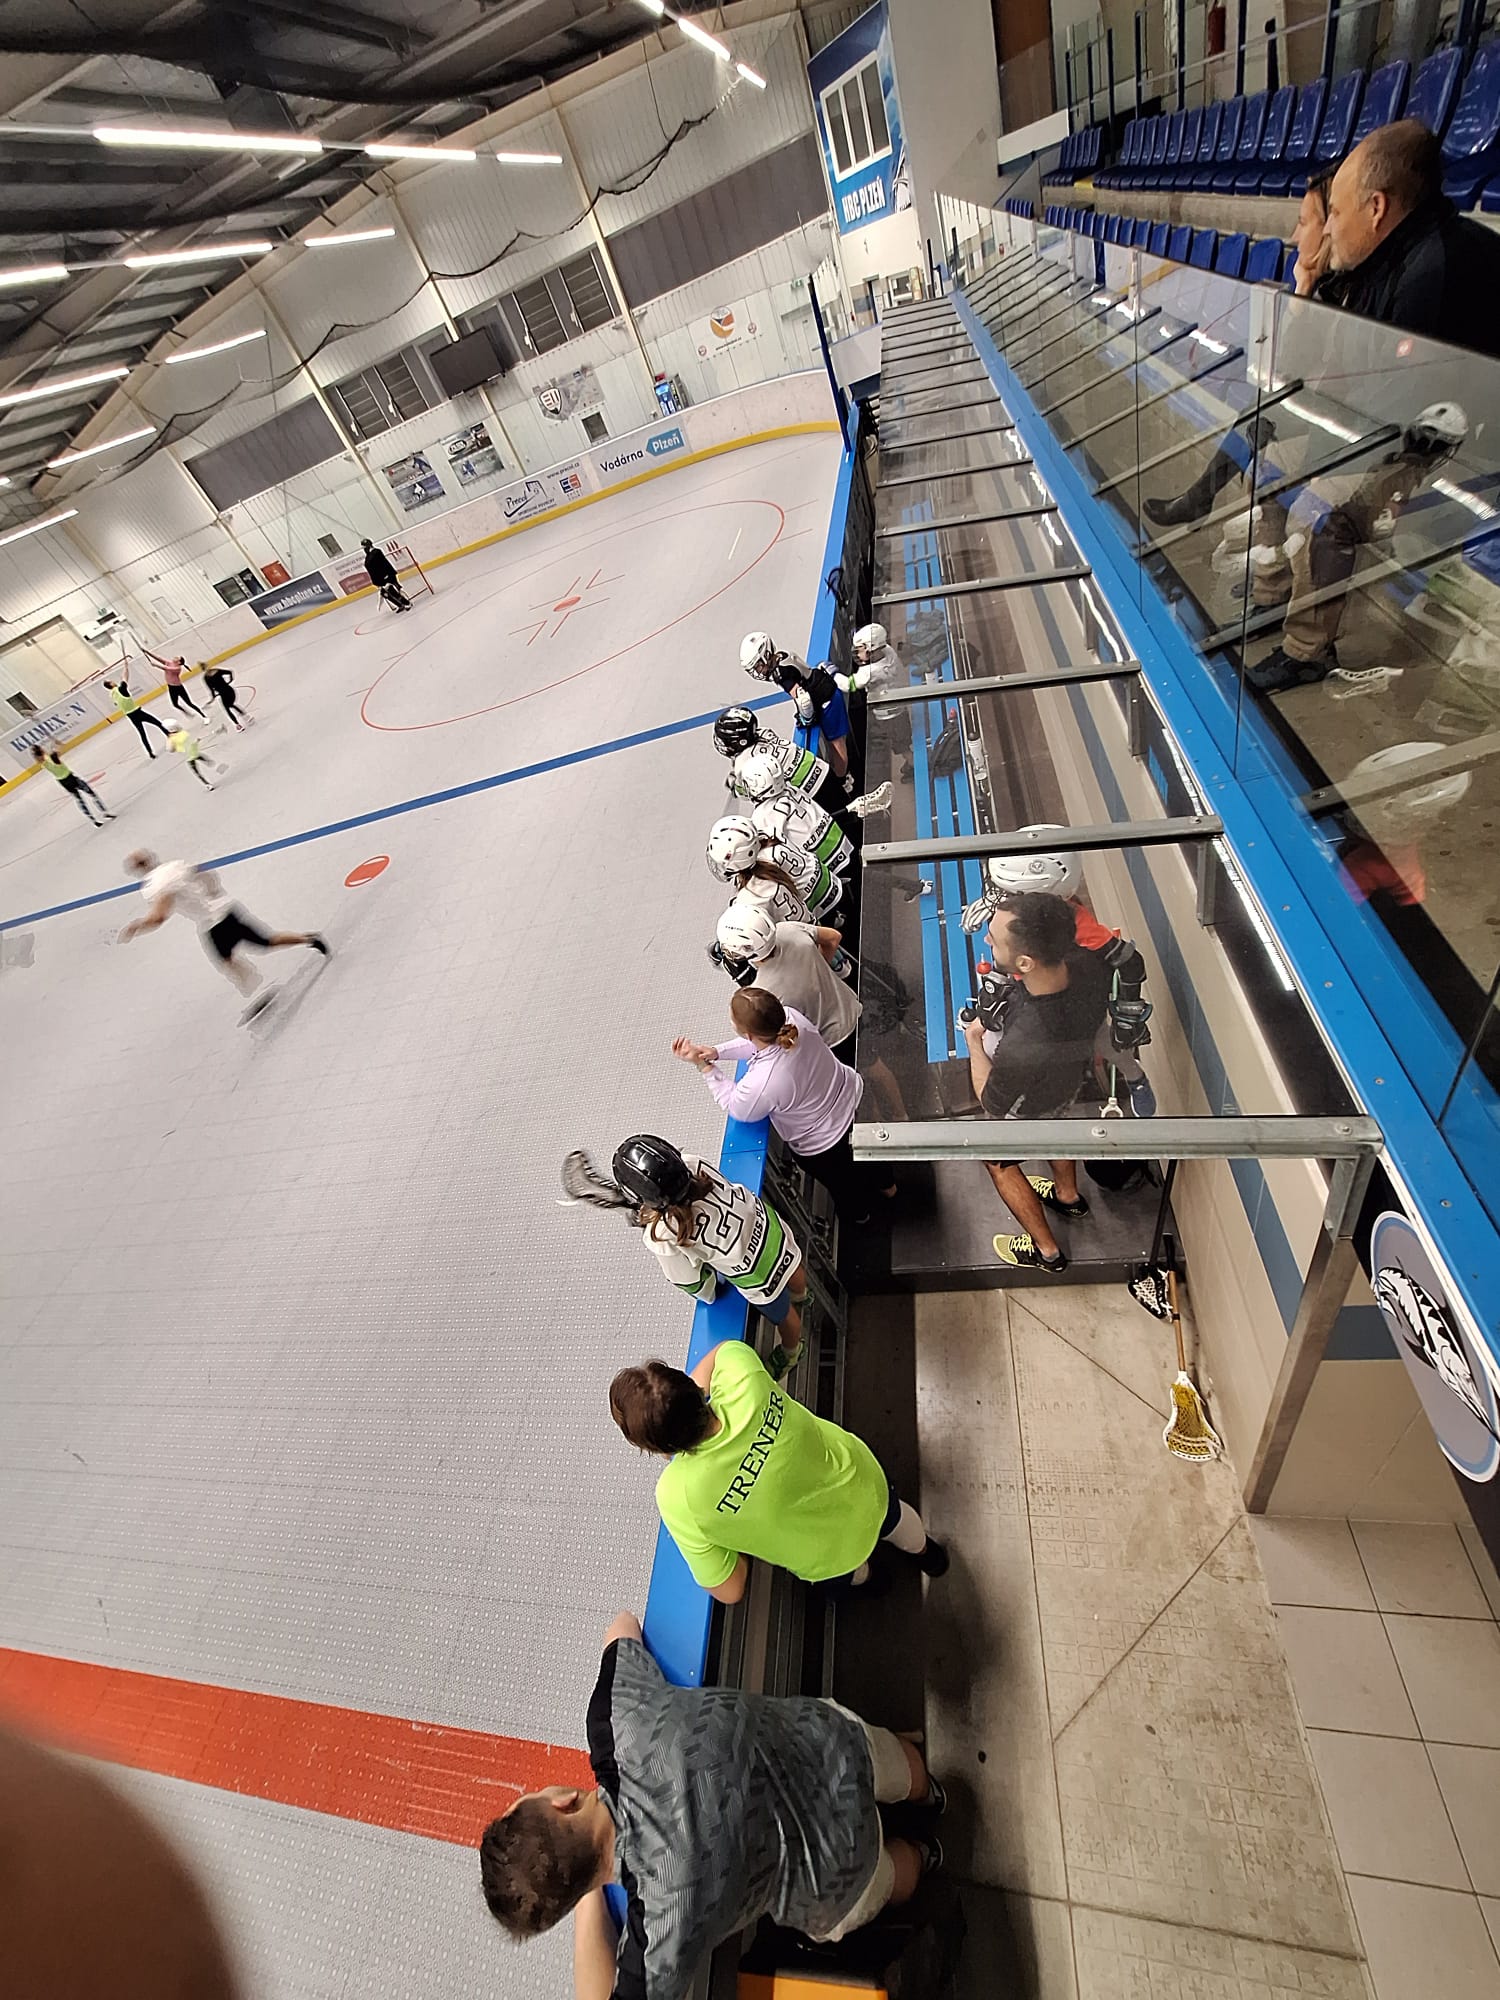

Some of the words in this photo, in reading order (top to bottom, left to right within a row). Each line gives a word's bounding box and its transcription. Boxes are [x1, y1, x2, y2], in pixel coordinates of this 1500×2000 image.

[841, 190, 862, 223] HBC
[859, 175, 886, 216] PLZEŇ
[600, 450, 643, 472] Vodárna
[652, 432, 681, 453] Plzeň
[506, 490, 528, 509] Precol
[10, 714, 67, 752] KLIMEX
[69, 702, 86, 716] N
[731, 1255, 751, 1272] OLD
[747, 1220, 764, 1255] DOGS
[764, 1255, 792, 1295] ISSPO
[716, 1391, 785, 1514] TRENÉR
